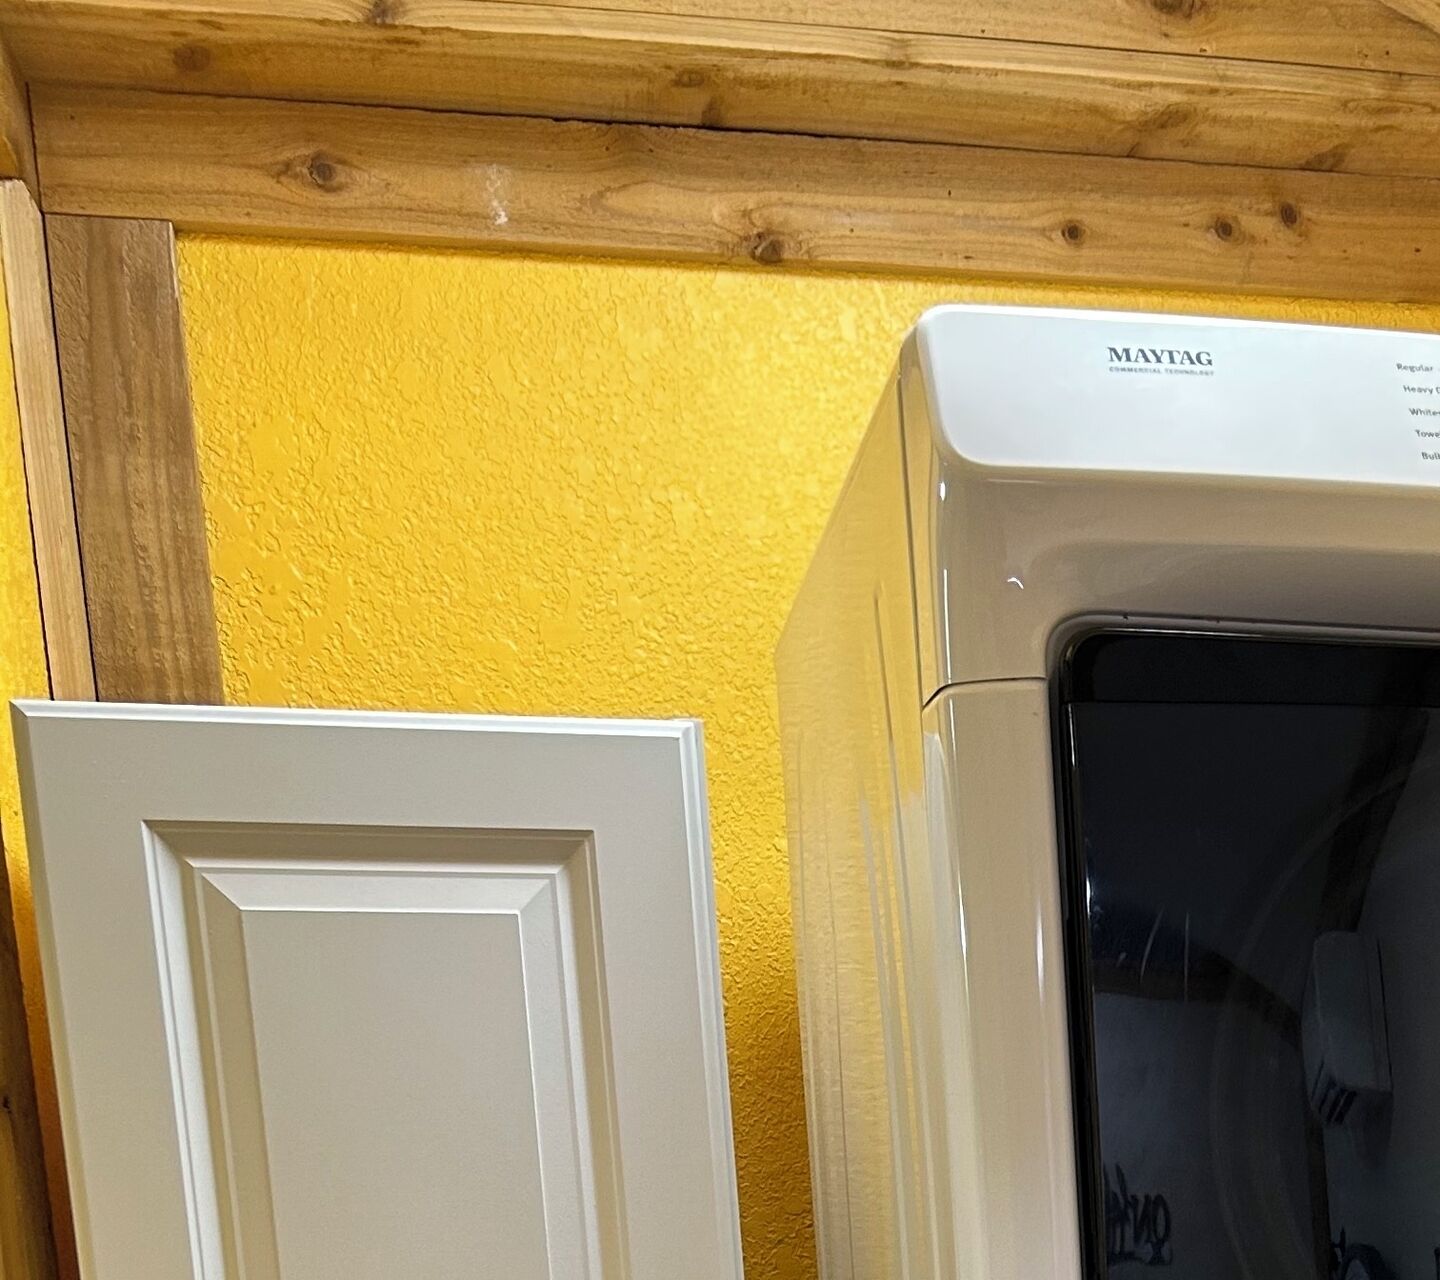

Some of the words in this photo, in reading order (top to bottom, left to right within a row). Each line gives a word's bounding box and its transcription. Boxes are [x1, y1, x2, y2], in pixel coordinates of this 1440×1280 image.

[1107, 346, 1213, 366] MAYTAG
[1396, 363, 1434, 373] Regular
[1403, 385, 1433, 395] Heavy
